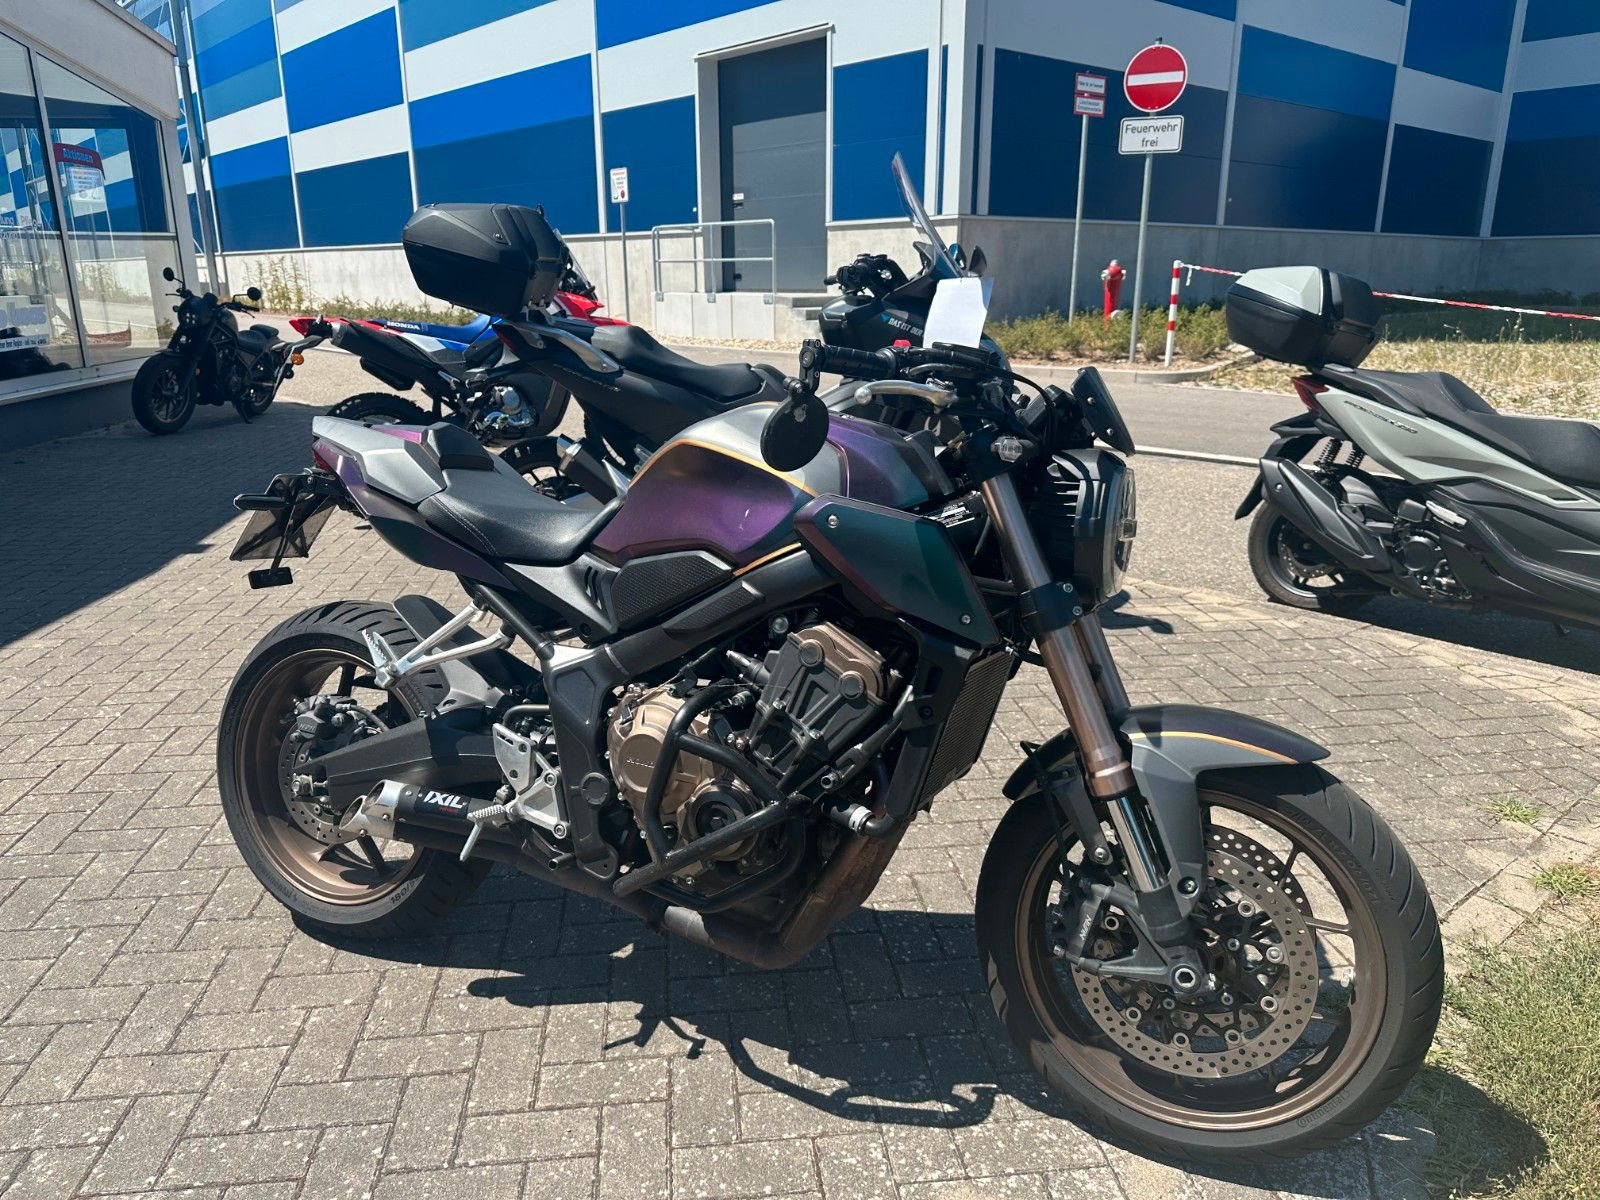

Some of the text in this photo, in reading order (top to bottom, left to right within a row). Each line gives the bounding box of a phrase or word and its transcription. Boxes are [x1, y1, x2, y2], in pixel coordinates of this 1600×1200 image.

[1125, 122, 1178, 133] Feuerwehr
[1141, 137, 1159, 147] frei
[386, 320, 420, 330] HONDA
[888, 317, 902, 328] DAS
[900, 322, 912, 331] IST
[423, 790, 463, 809] IXIL
